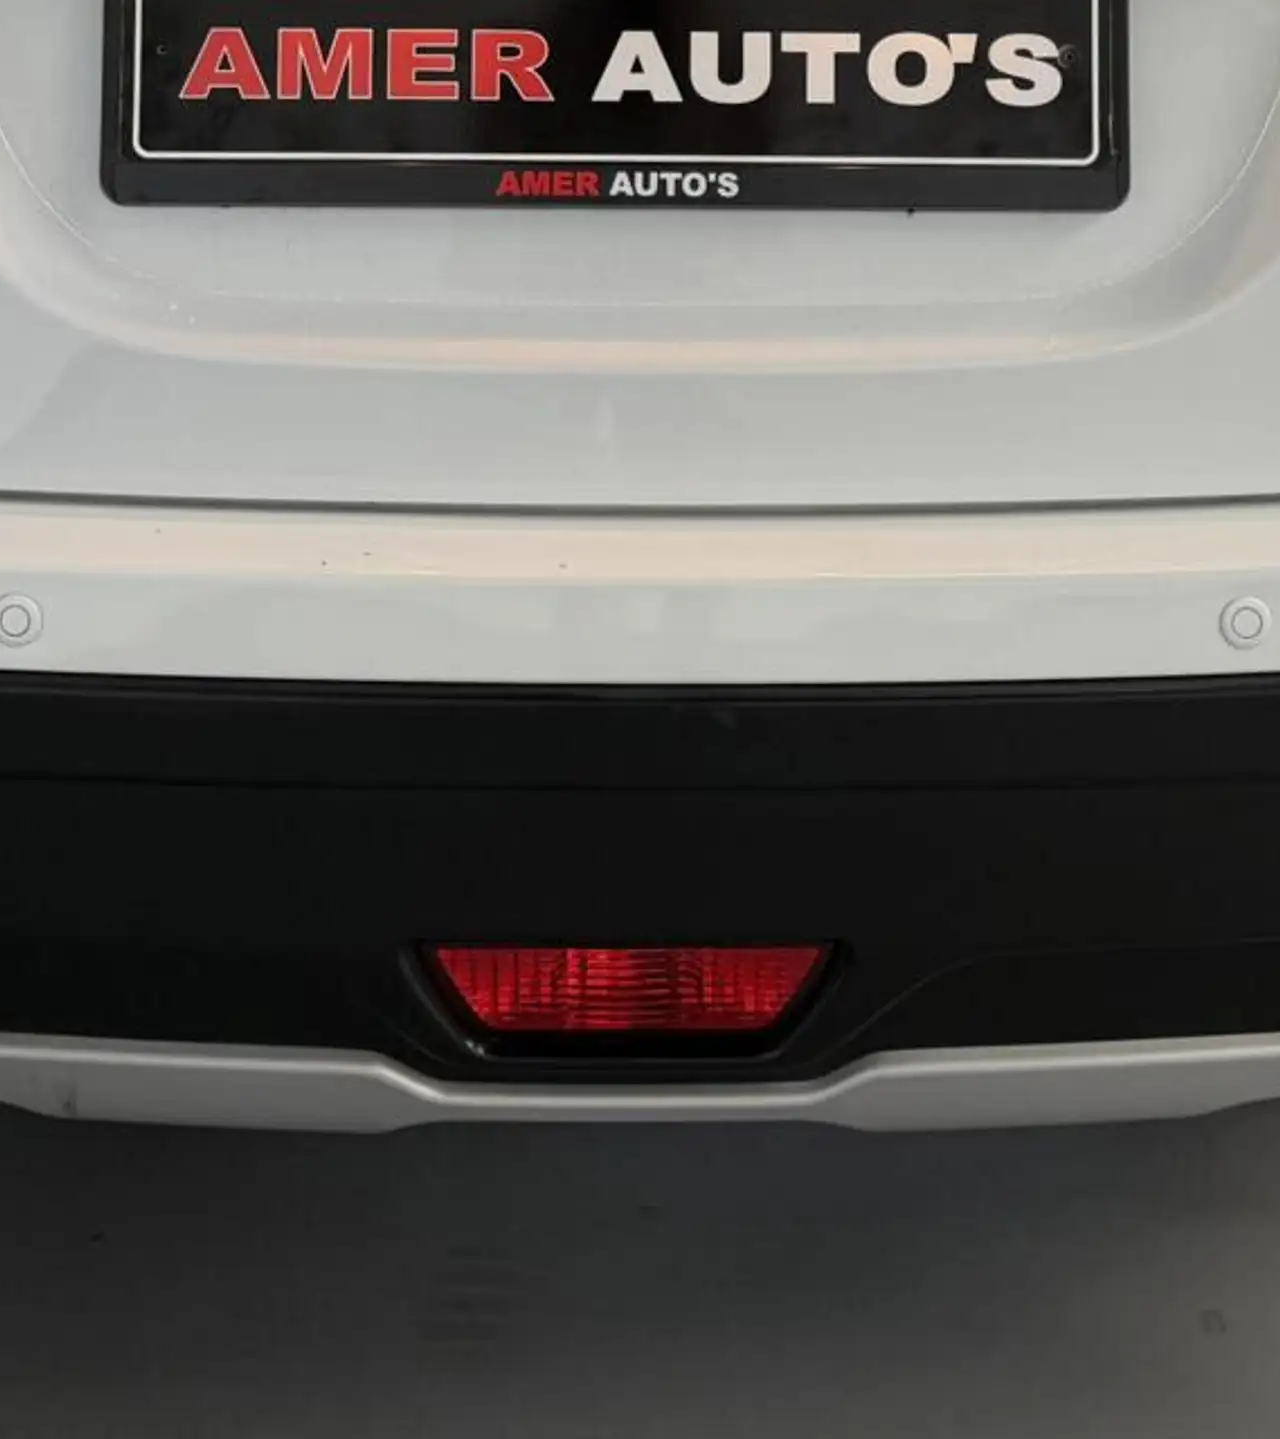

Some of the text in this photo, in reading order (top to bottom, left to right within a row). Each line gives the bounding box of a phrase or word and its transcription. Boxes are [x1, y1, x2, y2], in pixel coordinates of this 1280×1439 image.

[178, 26, 1064, 107] AMER AUTO'S
[496, 170, 740, 198] AMER AUTO'S
